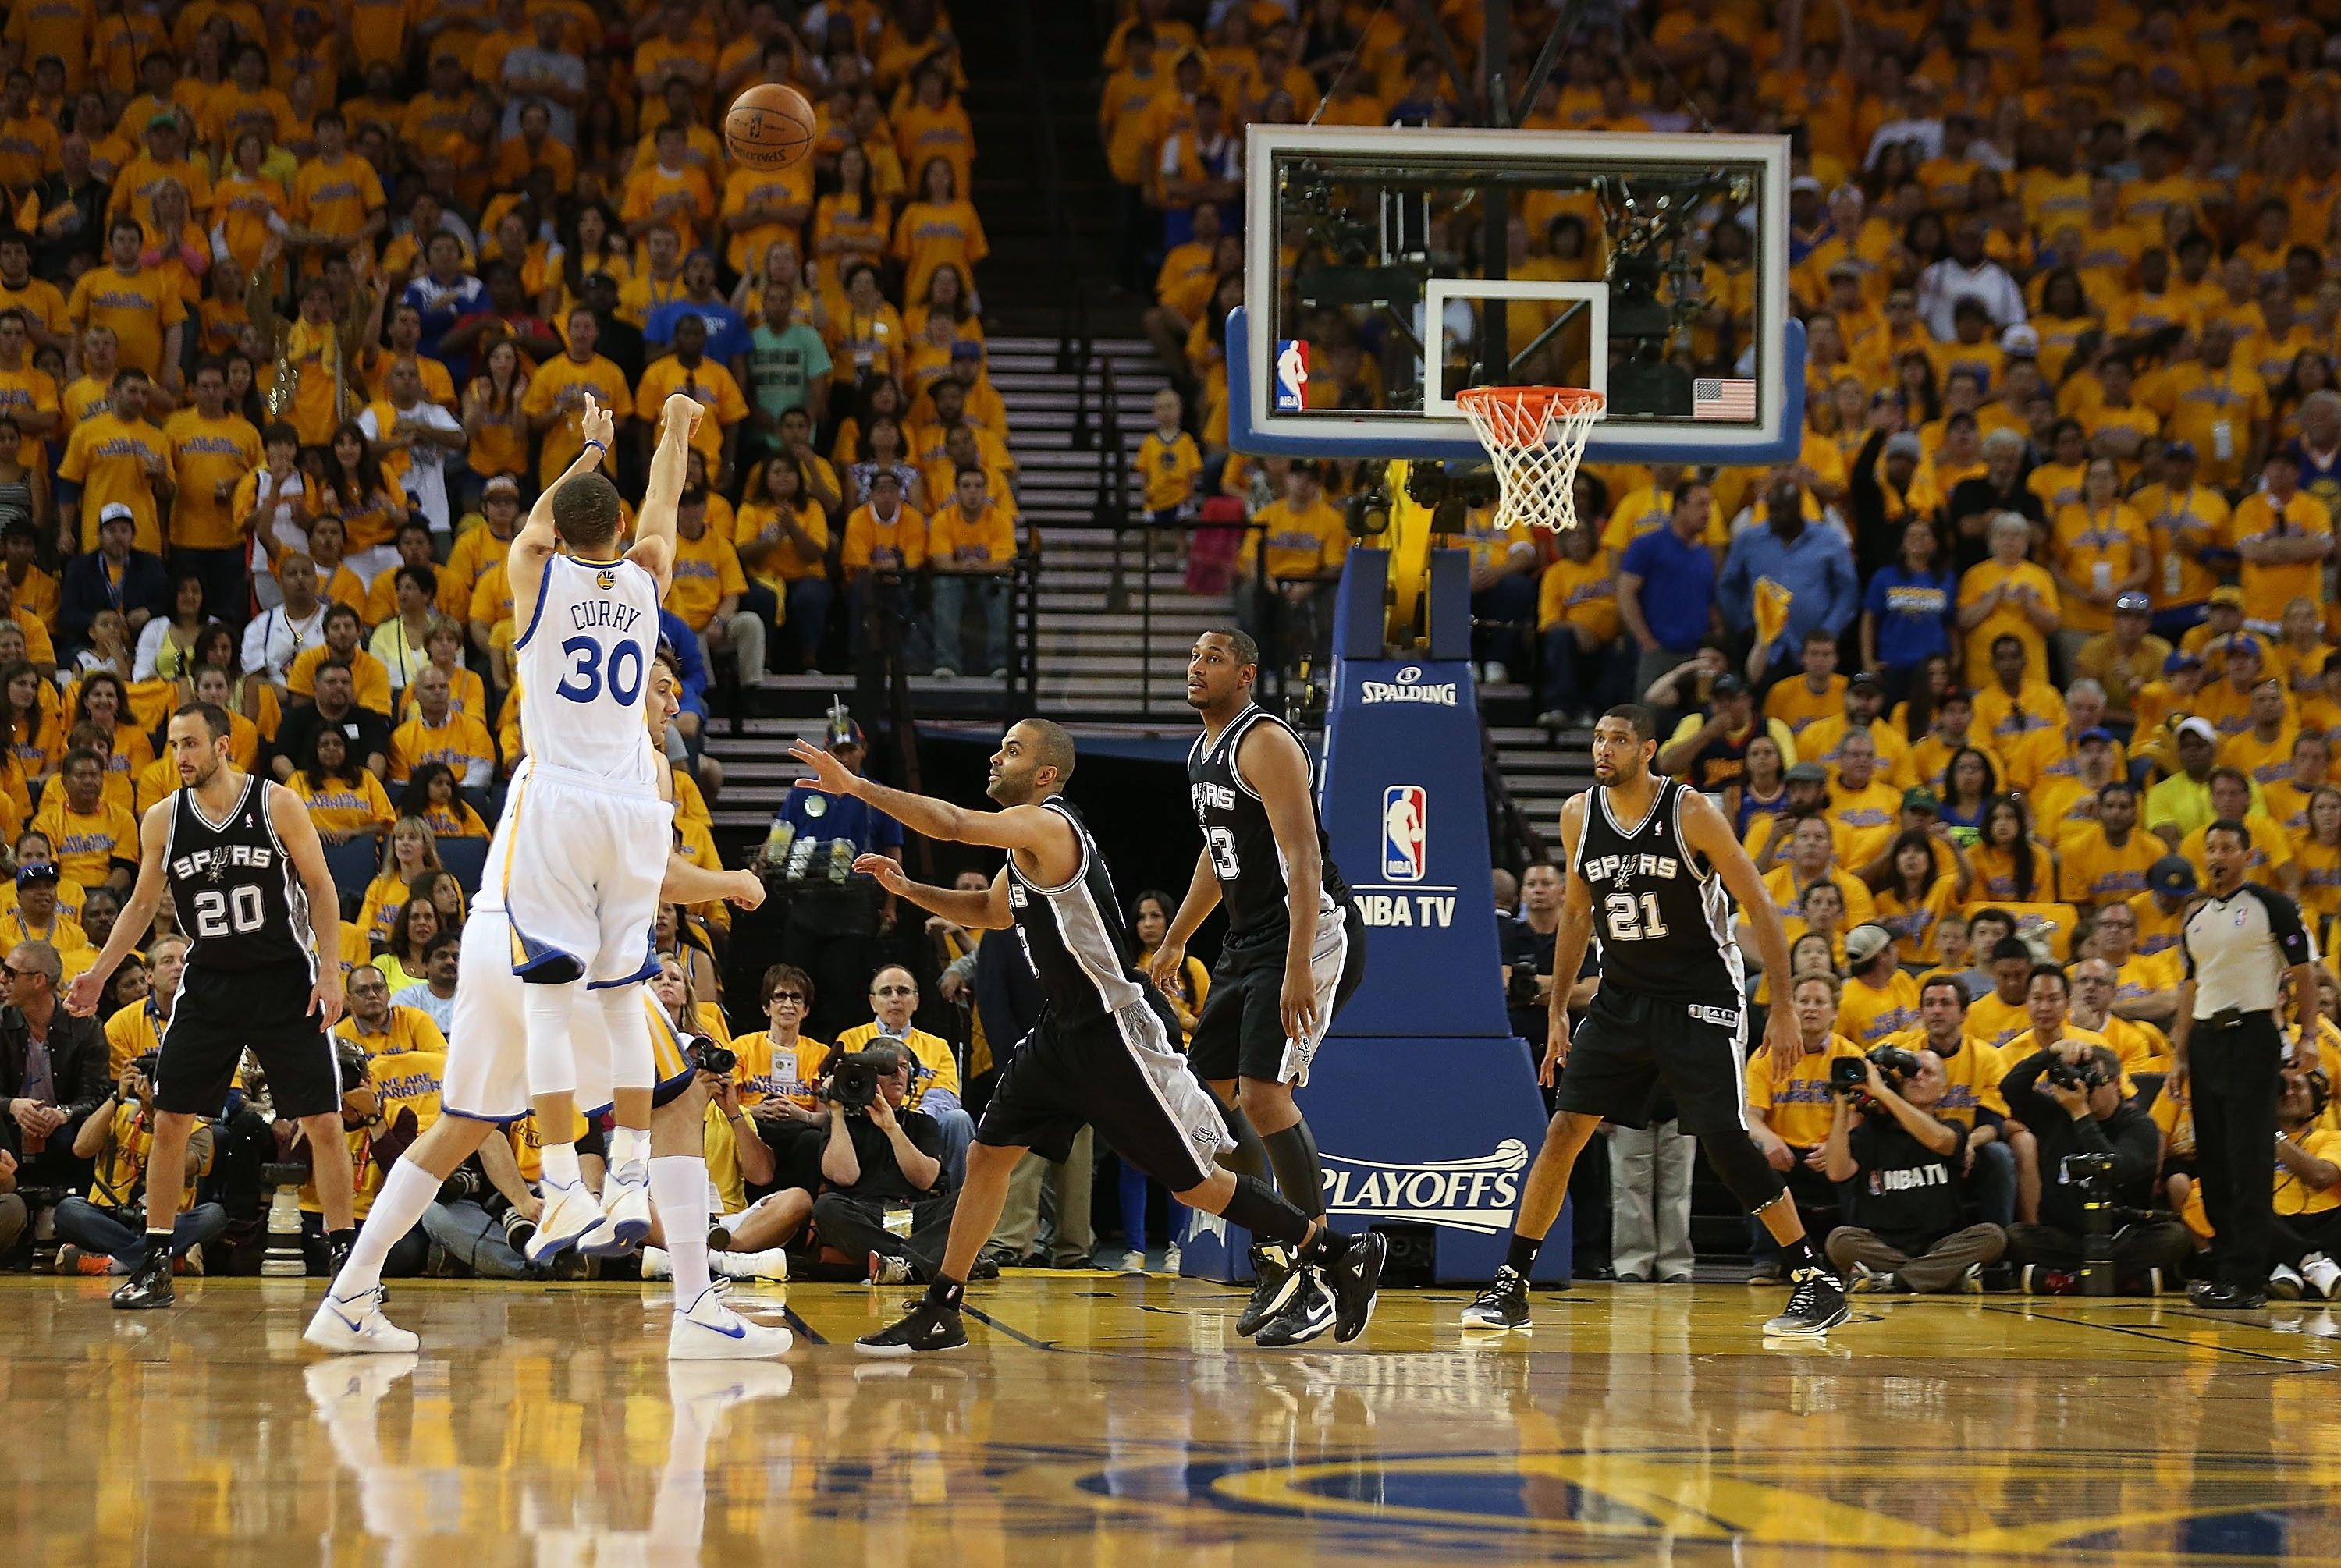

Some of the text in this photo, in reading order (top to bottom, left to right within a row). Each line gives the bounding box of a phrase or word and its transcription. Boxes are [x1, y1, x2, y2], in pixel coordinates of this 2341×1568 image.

[1279, 396, 1298, 406] NBA
[570, 601, 641, 633] CURRY
[555, 635, 645, 707] 30
[1361, 680, 1458, 708] SPALDING
[1191, 781, 1237, 824] PURS
[172, 844, 273, 884] SPURS
[1199, 824, 1242, 881] 3
[1583, 853, 1678, 891] SPURS
[193, 882, 266, 939] 20
[1352, 895, 1457, 928] NBA TV
[1604, 891, 1671, 942] 21
[1883, 1162, 1948, 1190] NBA TV
